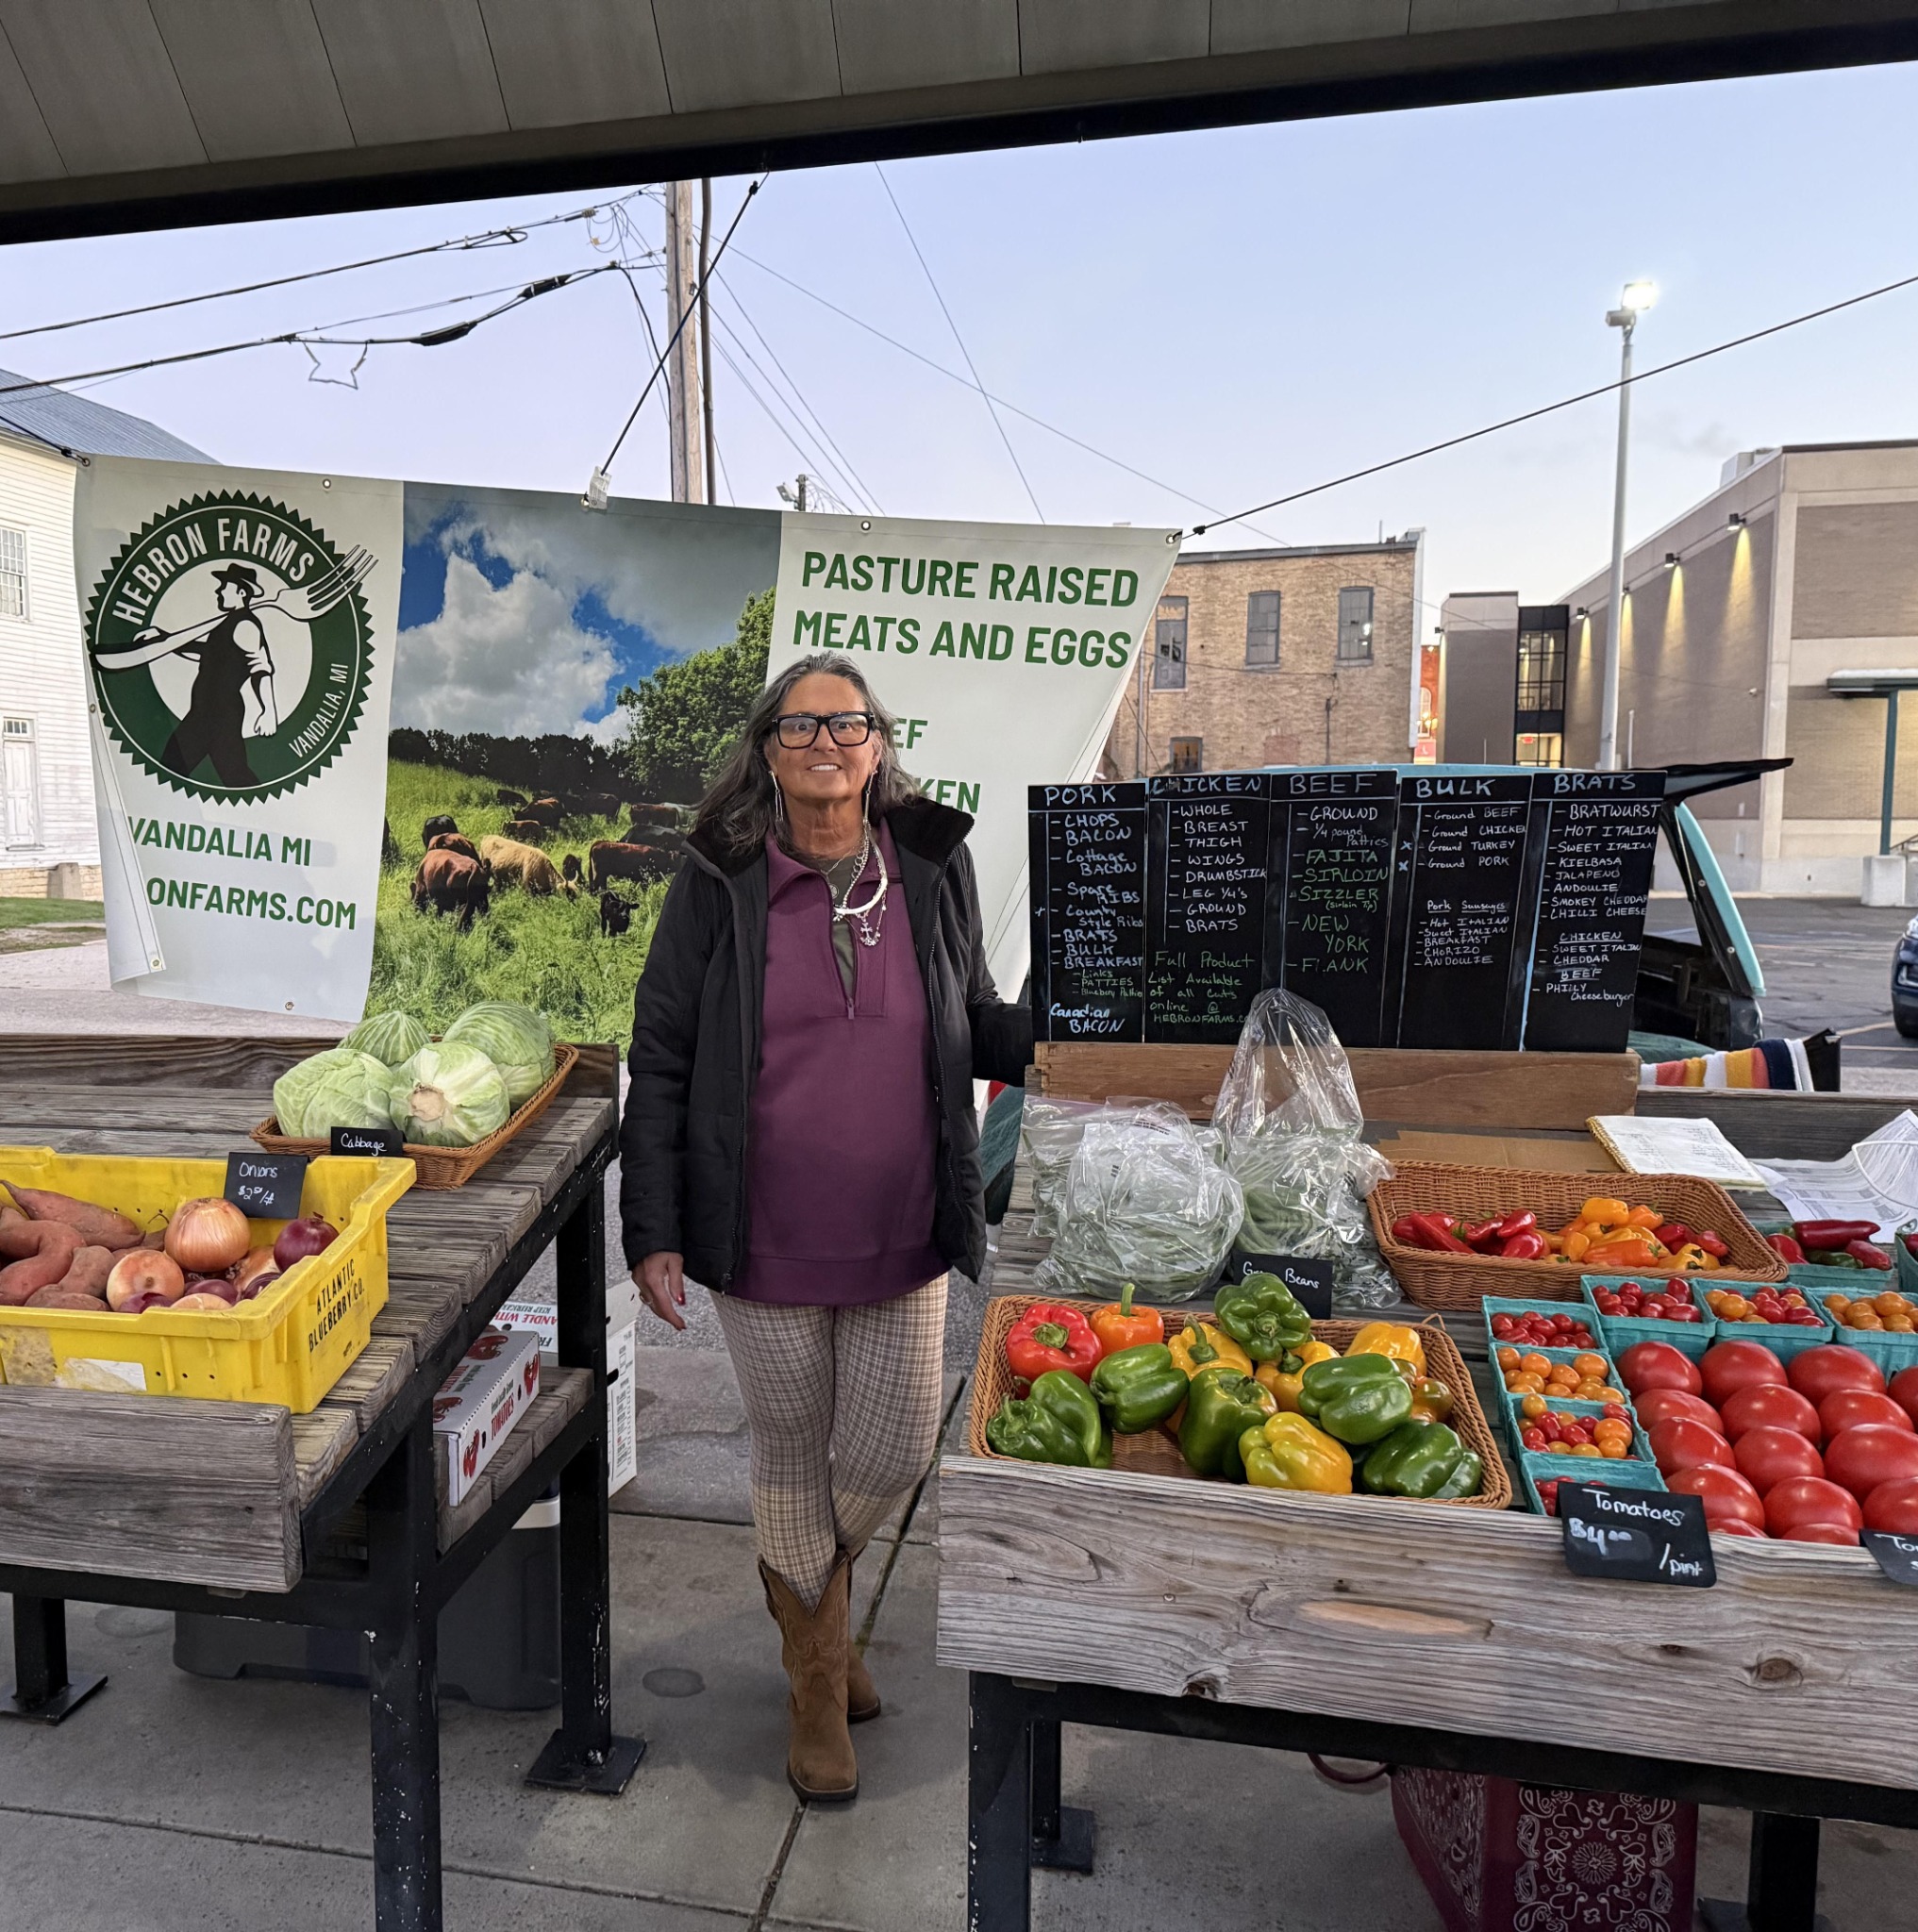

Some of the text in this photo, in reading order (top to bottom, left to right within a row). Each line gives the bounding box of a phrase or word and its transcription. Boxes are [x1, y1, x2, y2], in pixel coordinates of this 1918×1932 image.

[112, 518, 315, 625] HEBRON FARMS
[802, 551, 1139, 608] PASTURE RAISED
[792, 609, 1132, 669] MEATS AND EGGS
[289, 663, 349, 758] VANDALIA, MI
[1290, 774, 1377, 794] BEEF
[1416, 778, 1496, 798] BULK
[1554, 774, 1636, 794] BRATS
[1044, 785, 1116, 807] PORK
[1180, 804, 1233, 817] WHOLE
[1309, 806, 1378, 821] GROUND
[1434, 807, 1522, 820] Ground BEEF
[1569, 804, 1661, 820] BRATWURST
[1064, 813, 1120, 827] CHOPS
[1184, 820, 1249, 835] BREAST
[1331, 824, 1363, 841] pound
[1431, 825, 1468, 838] Ground
[1563, 824, 1597, 837] HOT
[127, 816, 311, 867] VANDALIA MI
[1065, 826, 1132, 846] BACON
[1184, 836, 1243, 848] THIGH
[1346, 834, 1389, 847] Patties
[1427, 839, 1516, 852] Ground TURKEY
[1557, 841, 1602, 853] SWEET
[1066, 849, 1127, 866] Cottage
[1188, 853, 1245, 865] WINGS
[1306, 849, 1378, 864] FAJITA
[1427, 856, 1509, 868] Ground PORK
[1559, 857, 1622, 868] KIELBASA
[1079, 862, 1137, 876] BACON
[1186, 868, 1267, 883] DRUMBSTICK
[1303, 866, 1389, 883] SIRLOIN
[1555, 870, 1621, 881] JALAPENO
[1067, 882, 1115, 901] Spare
[1182, 887, 1215, 899] LEG
[1298, 885, 1379, 902] SIZZLER
[1553, 883, 1619, 893] ANDOULIE
[146, 877, 357, 930] ONFARMS.COM
[1097, 891, 1141, 904] RIBS
[1551, 896, 1596, 907] SMOKEY
[1187, 903, 1246, 916] GROUND
[1426, 899, 1452, 911] Pork
[1550, 907, 1647, 920] CHILLI CHEESE
[1186, 919, 1238, 933] BRATS
[1302, 913, 1349, 932] NEW
[1429, 917, 1450, 927] Hot
[1063, 928, 1118, 942] BRATS
[1424, 927, 1454, 937] Sweet
[1559, 931, 1622, 941] CHICKEN
[1066, 943, 1114, 957] BULK
[1325, 934, 1370, 954] YORK
[1552, 944, 1597, 954] SWEET
[1064, 956, 1143, 969] BREAKFAST
[1155, 951, 1256, 968] Full Product
[1553, 954, 1609, 965] CHEDDAR
[1081, 969, 1113, 978] Links
[1148, 972, 1243, 986] List Available
[1560, 968, 1603, 979] BEEF
[1081, 977, 1133, 988] PATTIES
[1149, 985, 1164, 997] of
[1177, 988, 1194, 997] all
[1050, 1003, 1110, 1018] Canadian
[1208, 1001, 1221, 1013] @
[1069, 1018, 1126, 1033] BACON
[340, 1132, 388, 1156] Cabbage
[239, 1161, 278, 1178] Onions
[1285, 1267, 1320, 1289] Beans
[316, 1258, 355, 1316] ATLANTIC
[308, 1277, 366, 1353] BLUEBERRY CO.
[521, 1313, 559, 1325] ANDLE
[1581, 1489, 1686, 1526] Tomatoes
